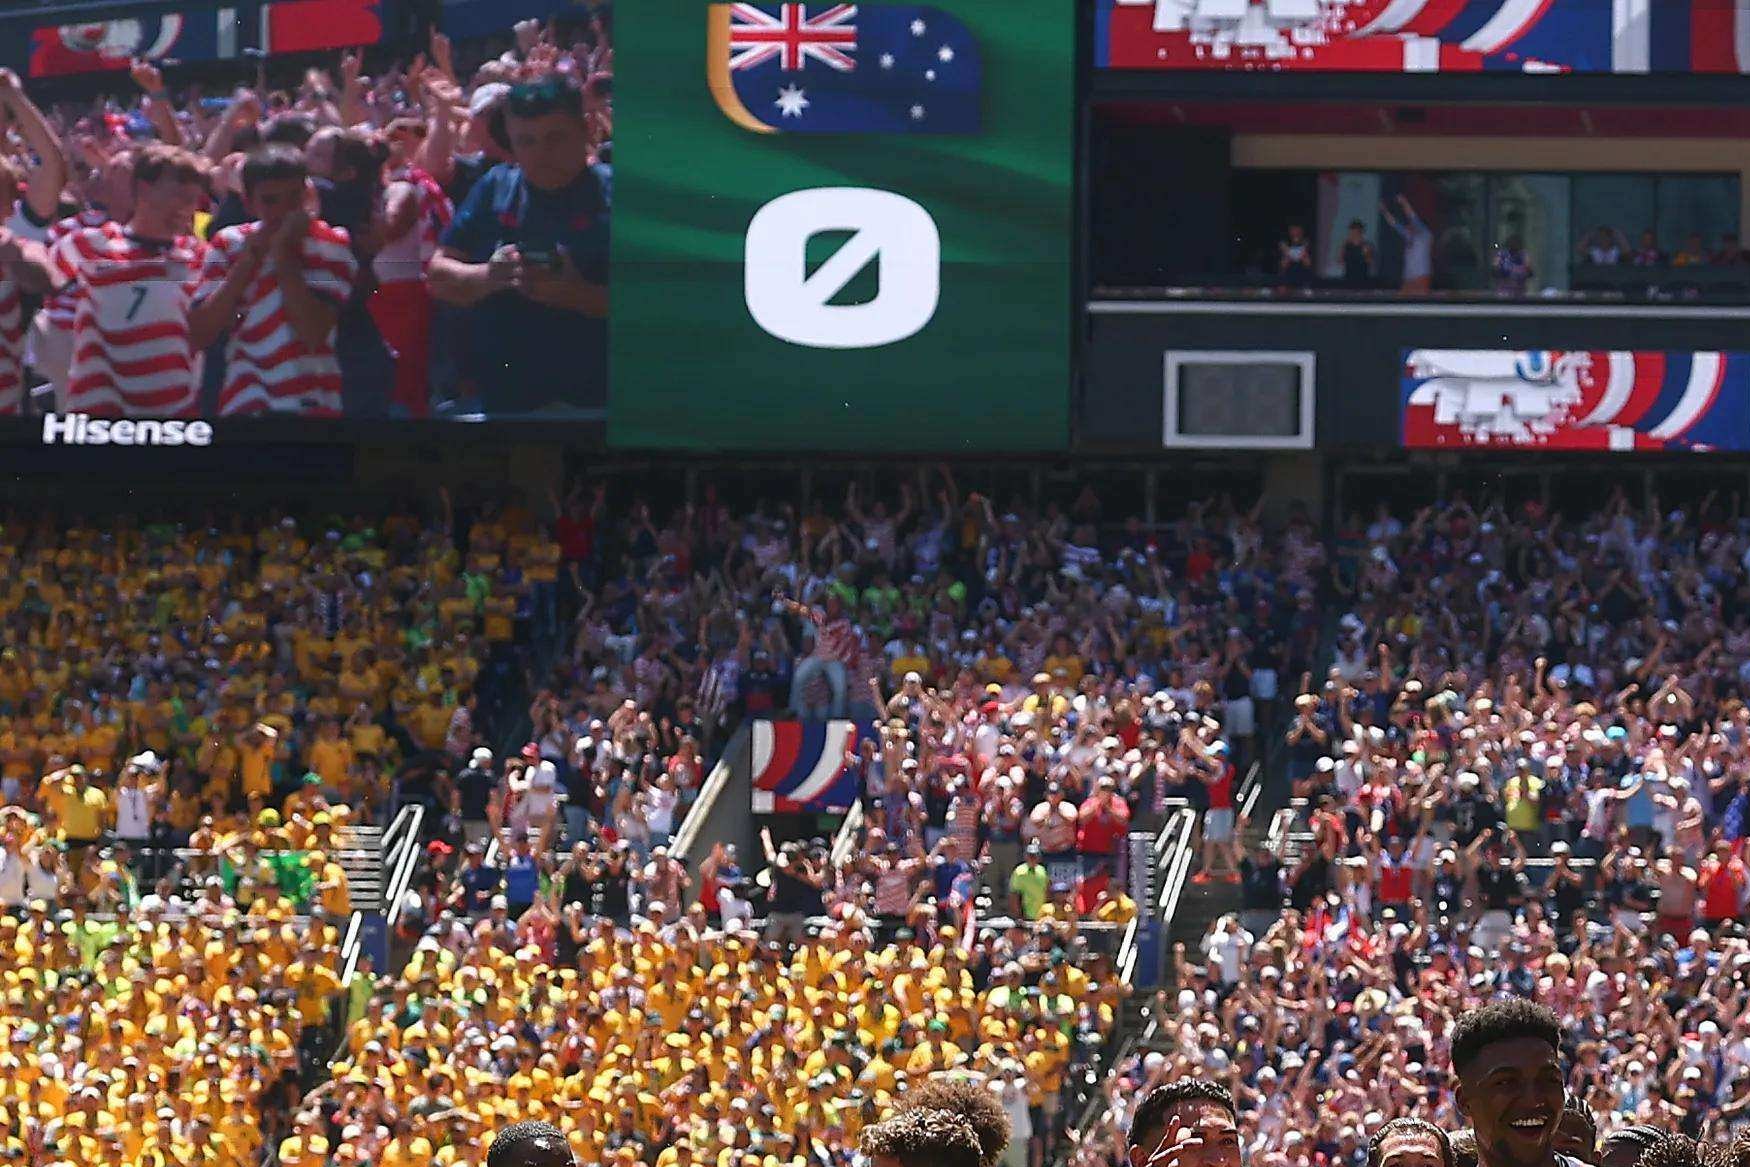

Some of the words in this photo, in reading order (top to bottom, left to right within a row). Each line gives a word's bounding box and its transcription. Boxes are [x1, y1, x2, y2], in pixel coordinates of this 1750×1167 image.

[744, 186, 940, 349] 0
[126, 286, 148, 321] 7
[43, 412, 214, 446] Hisense
